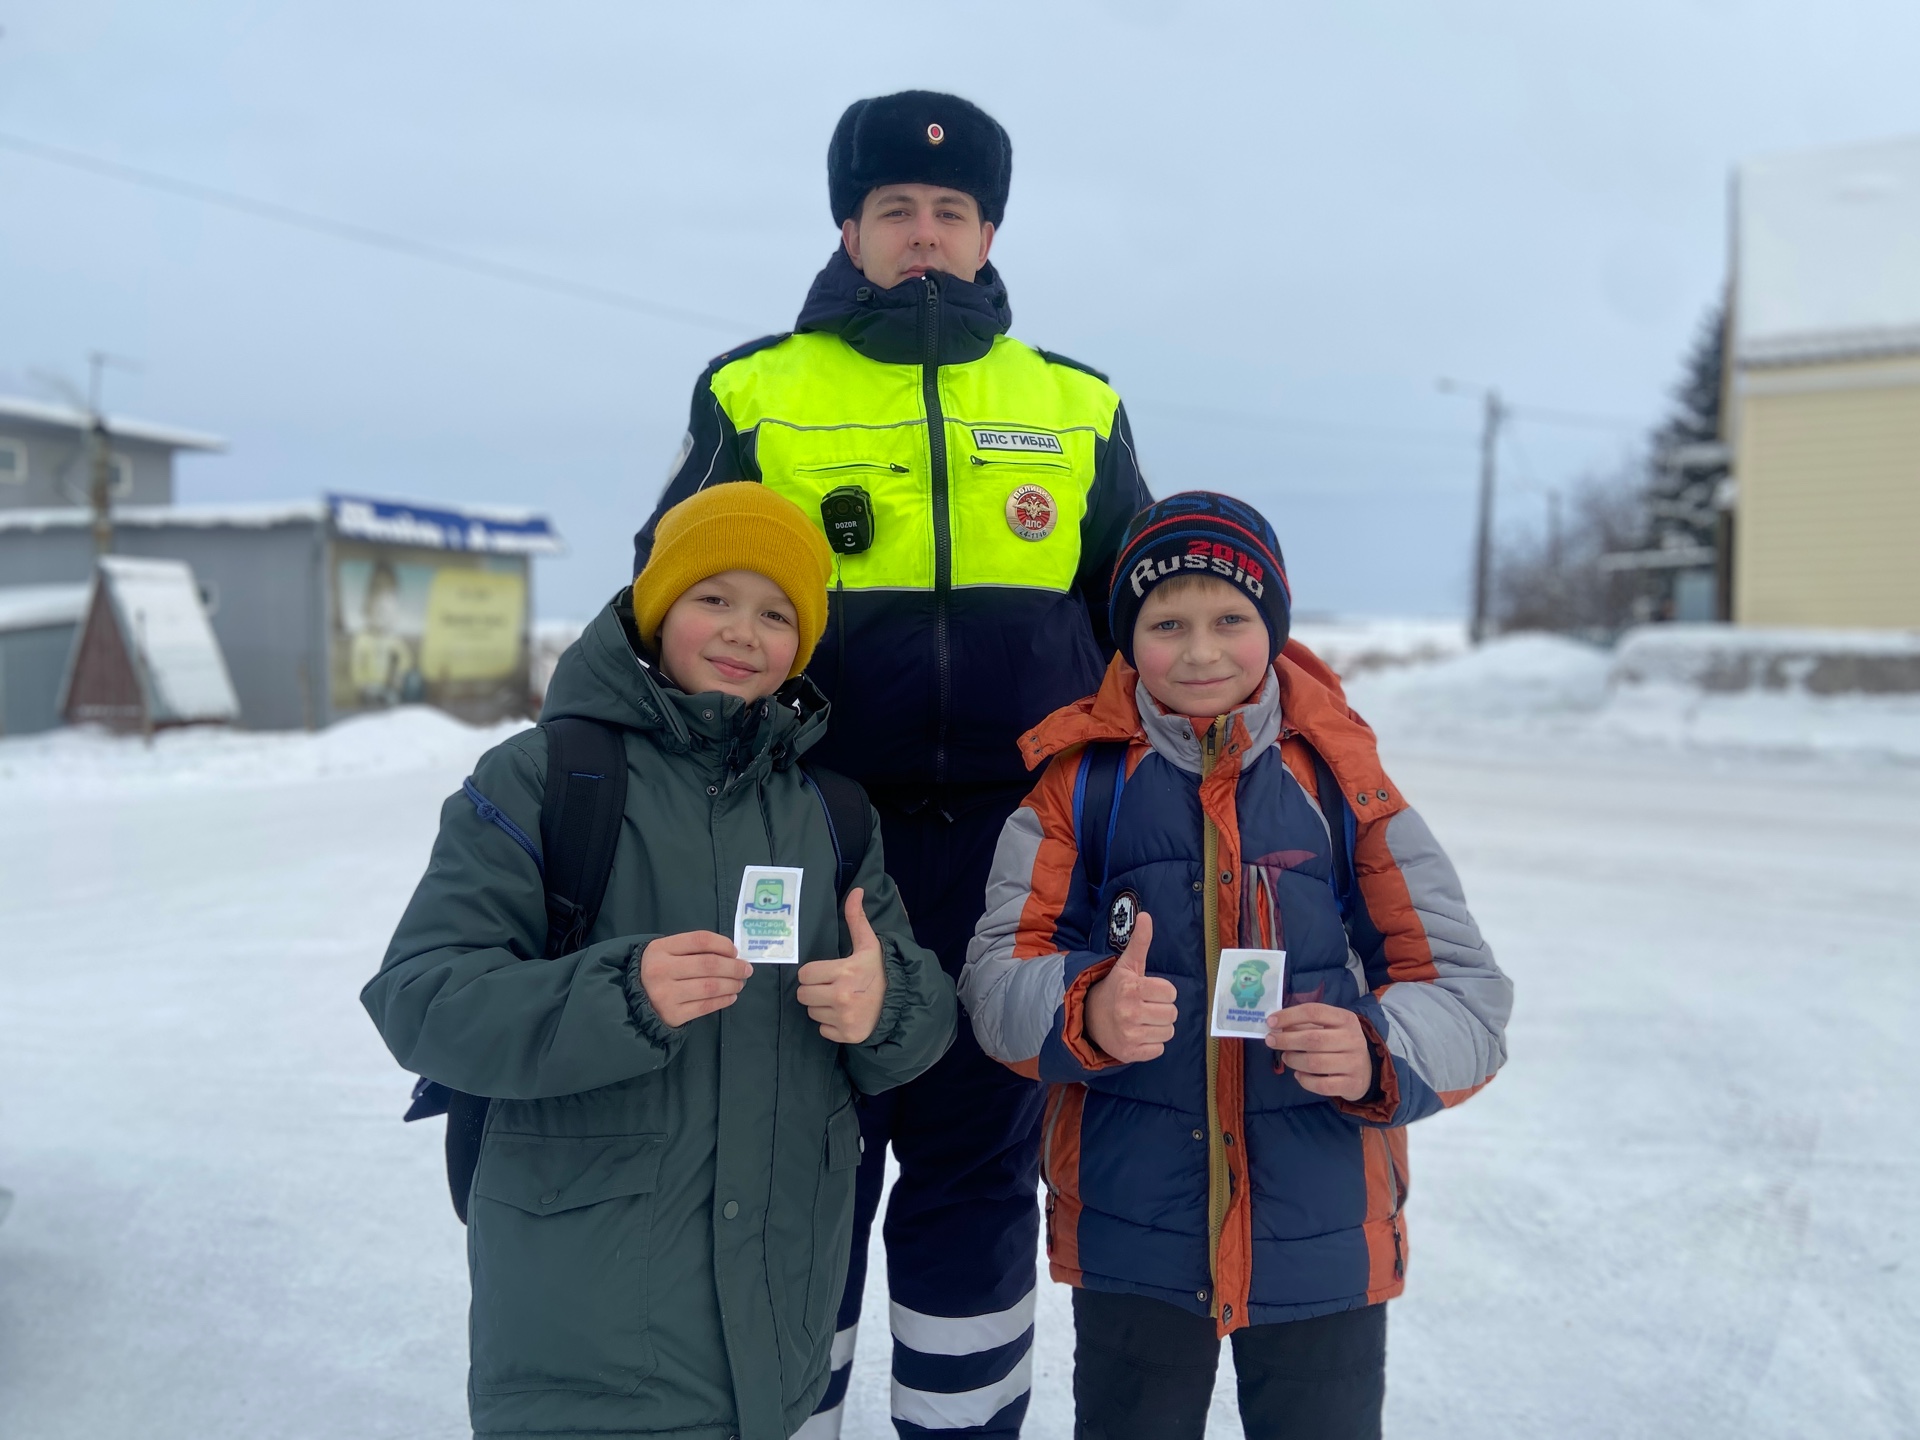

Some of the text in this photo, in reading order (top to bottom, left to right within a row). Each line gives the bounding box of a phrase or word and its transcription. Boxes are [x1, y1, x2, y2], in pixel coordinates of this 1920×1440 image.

[980, 433, 1058, 449] ДПС ГИБДД
[1013, 486, 1052, 502] ПОЛИЦИЯ
[835, 521, 857, 529] DOZOR
[1025, 519, 1042, 529] ДПС
[1188, 540, 1264, 581] 2018
[1130, 554, 1264, 599] Russia
[1228, 1008, 1265, 1016] ВНИМАНИЕ
